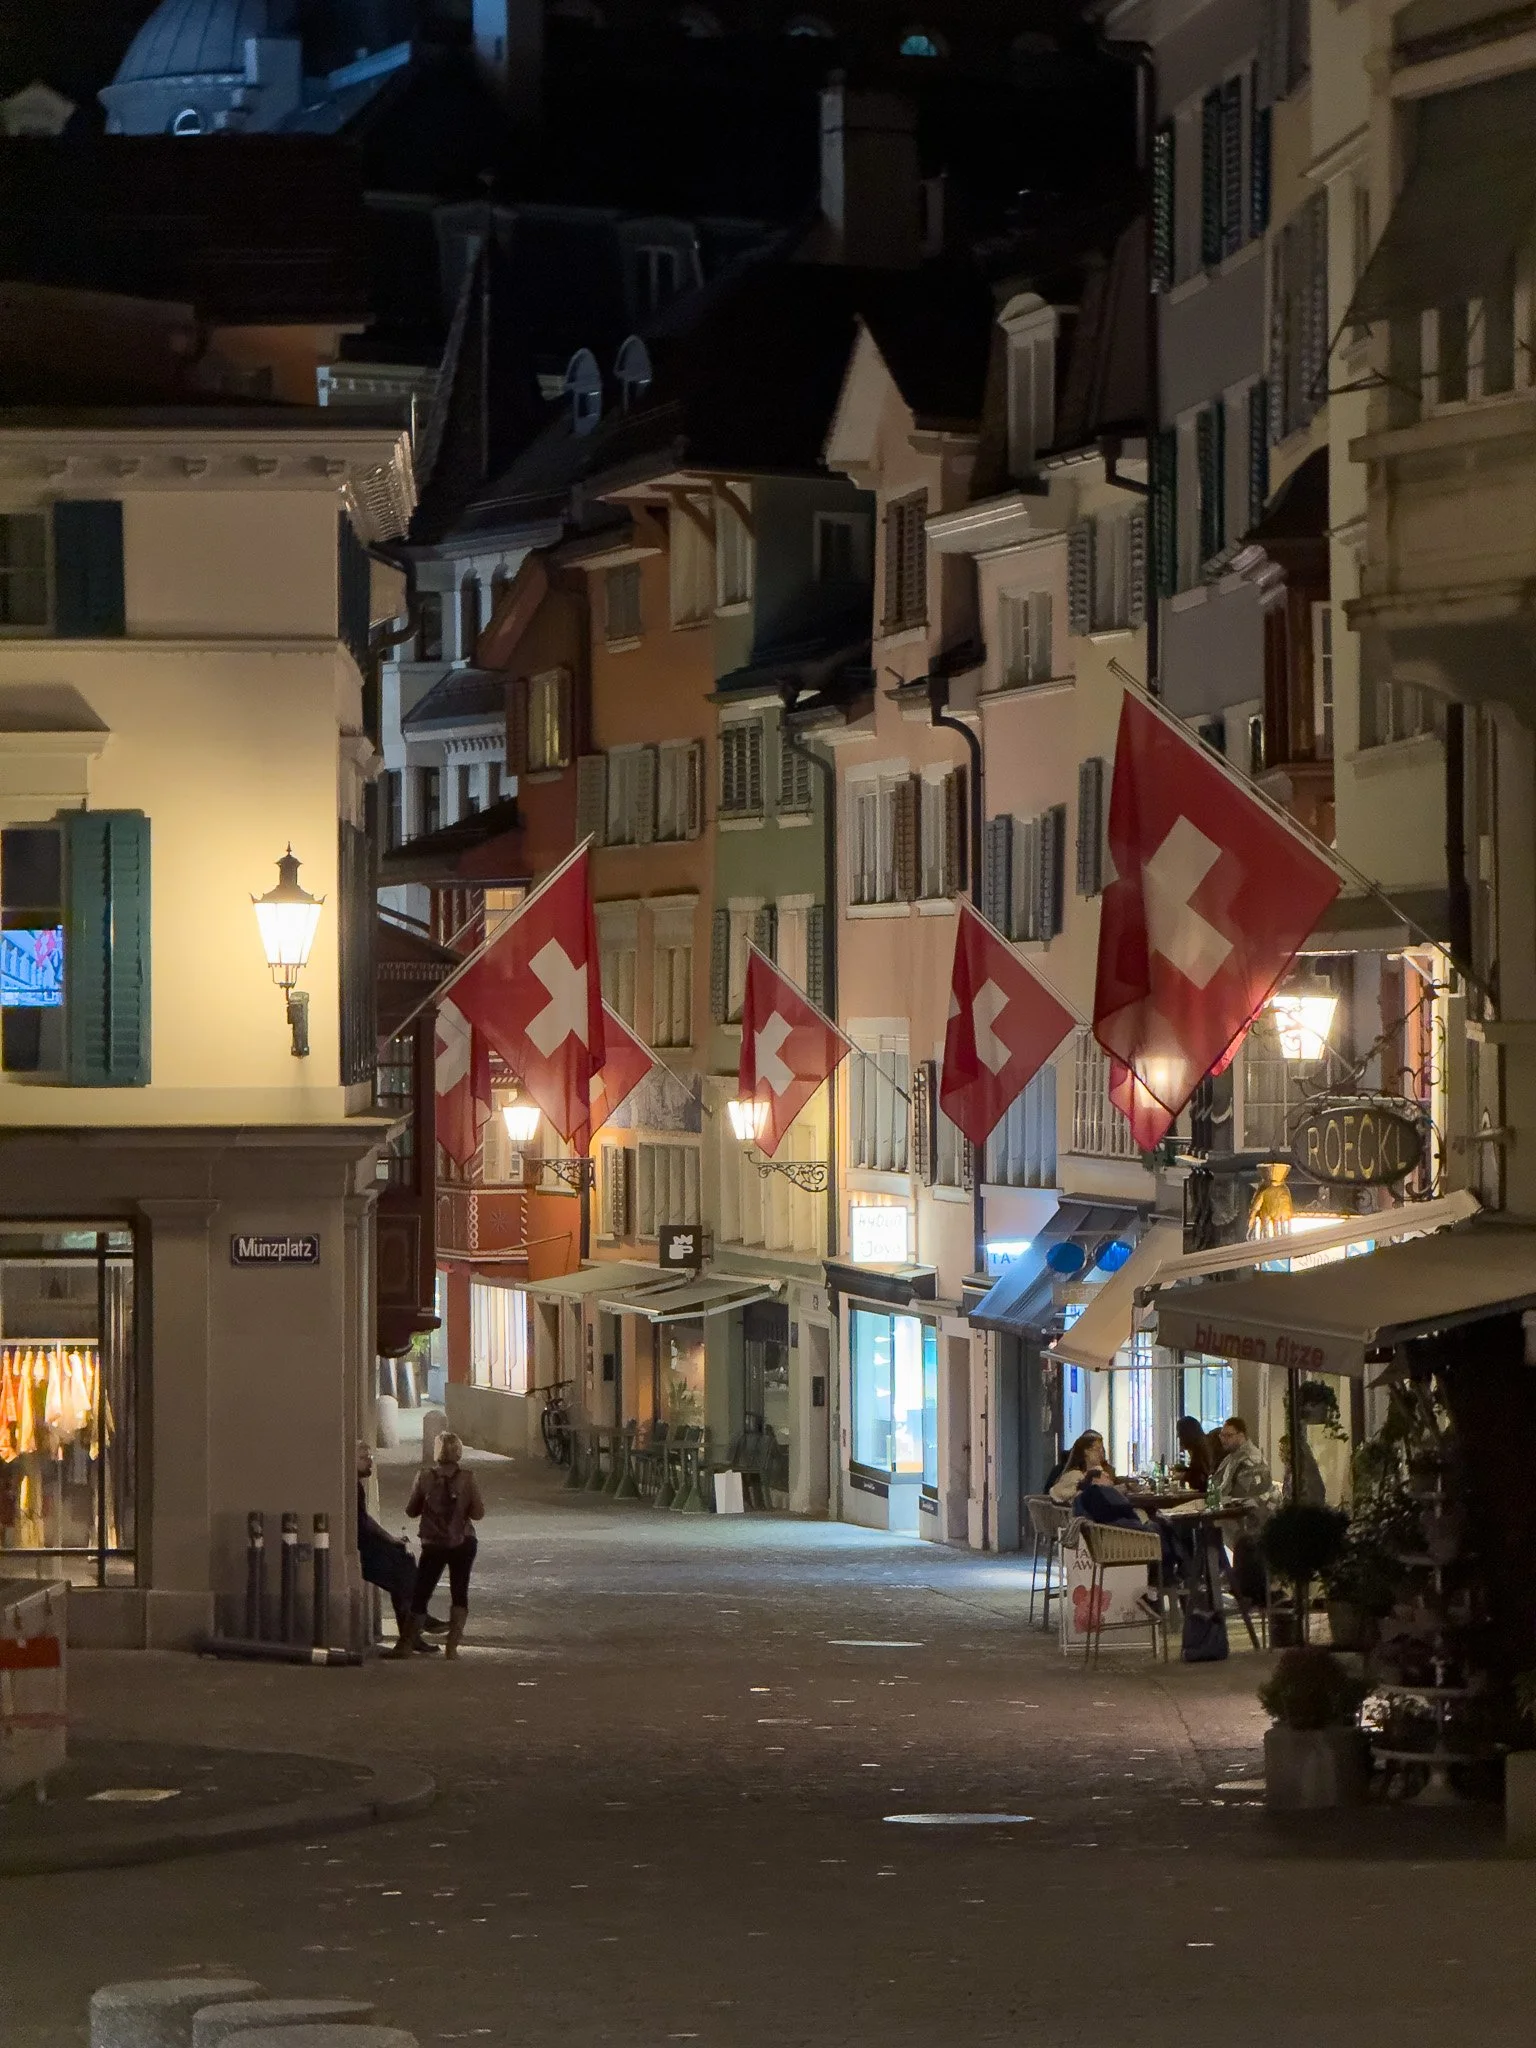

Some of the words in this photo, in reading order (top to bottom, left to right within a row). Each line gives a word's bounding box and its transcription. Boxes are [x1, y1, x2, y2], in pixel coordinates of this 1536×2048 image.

[1307, 1114, 1406, 1179] ROECKL
[239, 1238, 312, 1261] Münzplatz
[1194, 1323, 1266, 1359] blumen
[1073, 1560, 1093, 1570] AW
